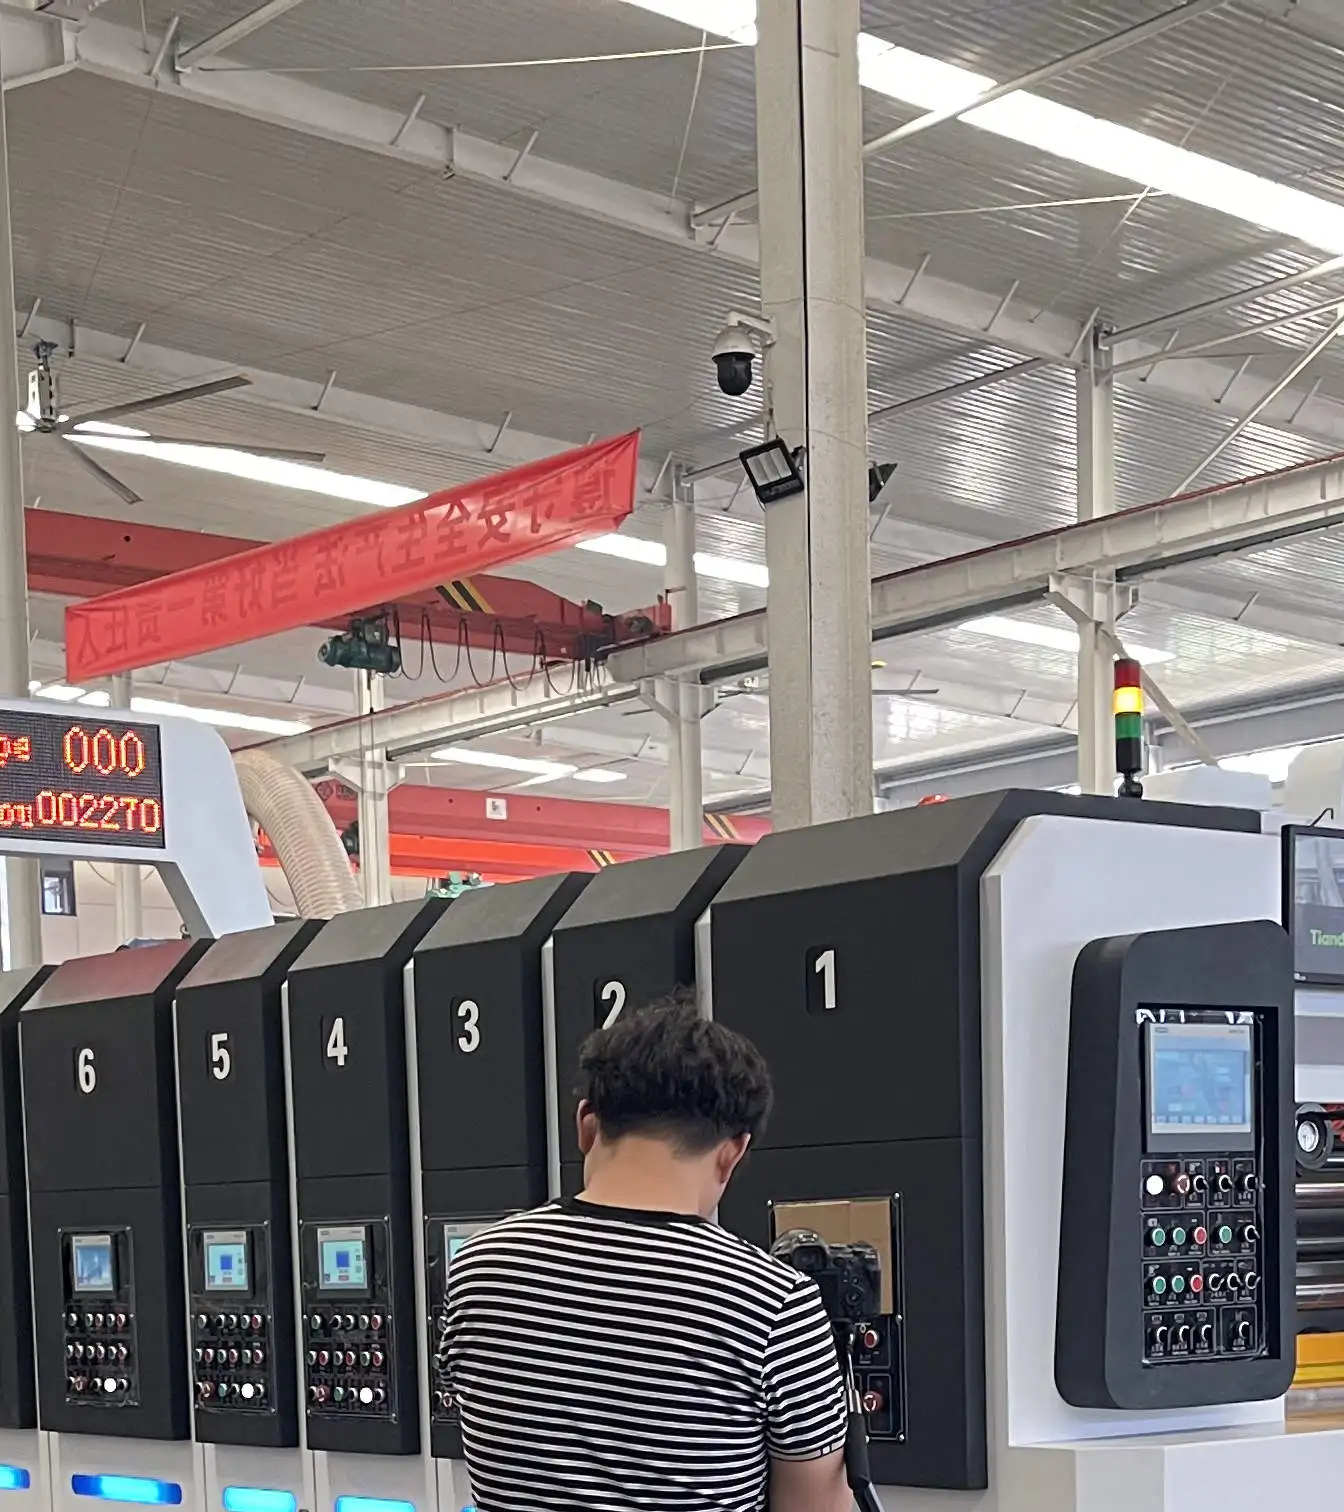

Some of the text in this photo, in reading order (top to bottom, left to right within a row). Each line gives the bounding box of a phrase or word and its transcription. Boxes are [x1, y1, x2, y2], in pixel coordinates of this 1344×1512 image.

[64, 726, 145, 778] 000
[814, 950, 837, 1010] 1
[326, 1017, 348, 1066] 4
[458, 1000, 480, 1053] 3
[78, 1048, 97, 1094] 6
[211, 1033, 231, 1080] 5
